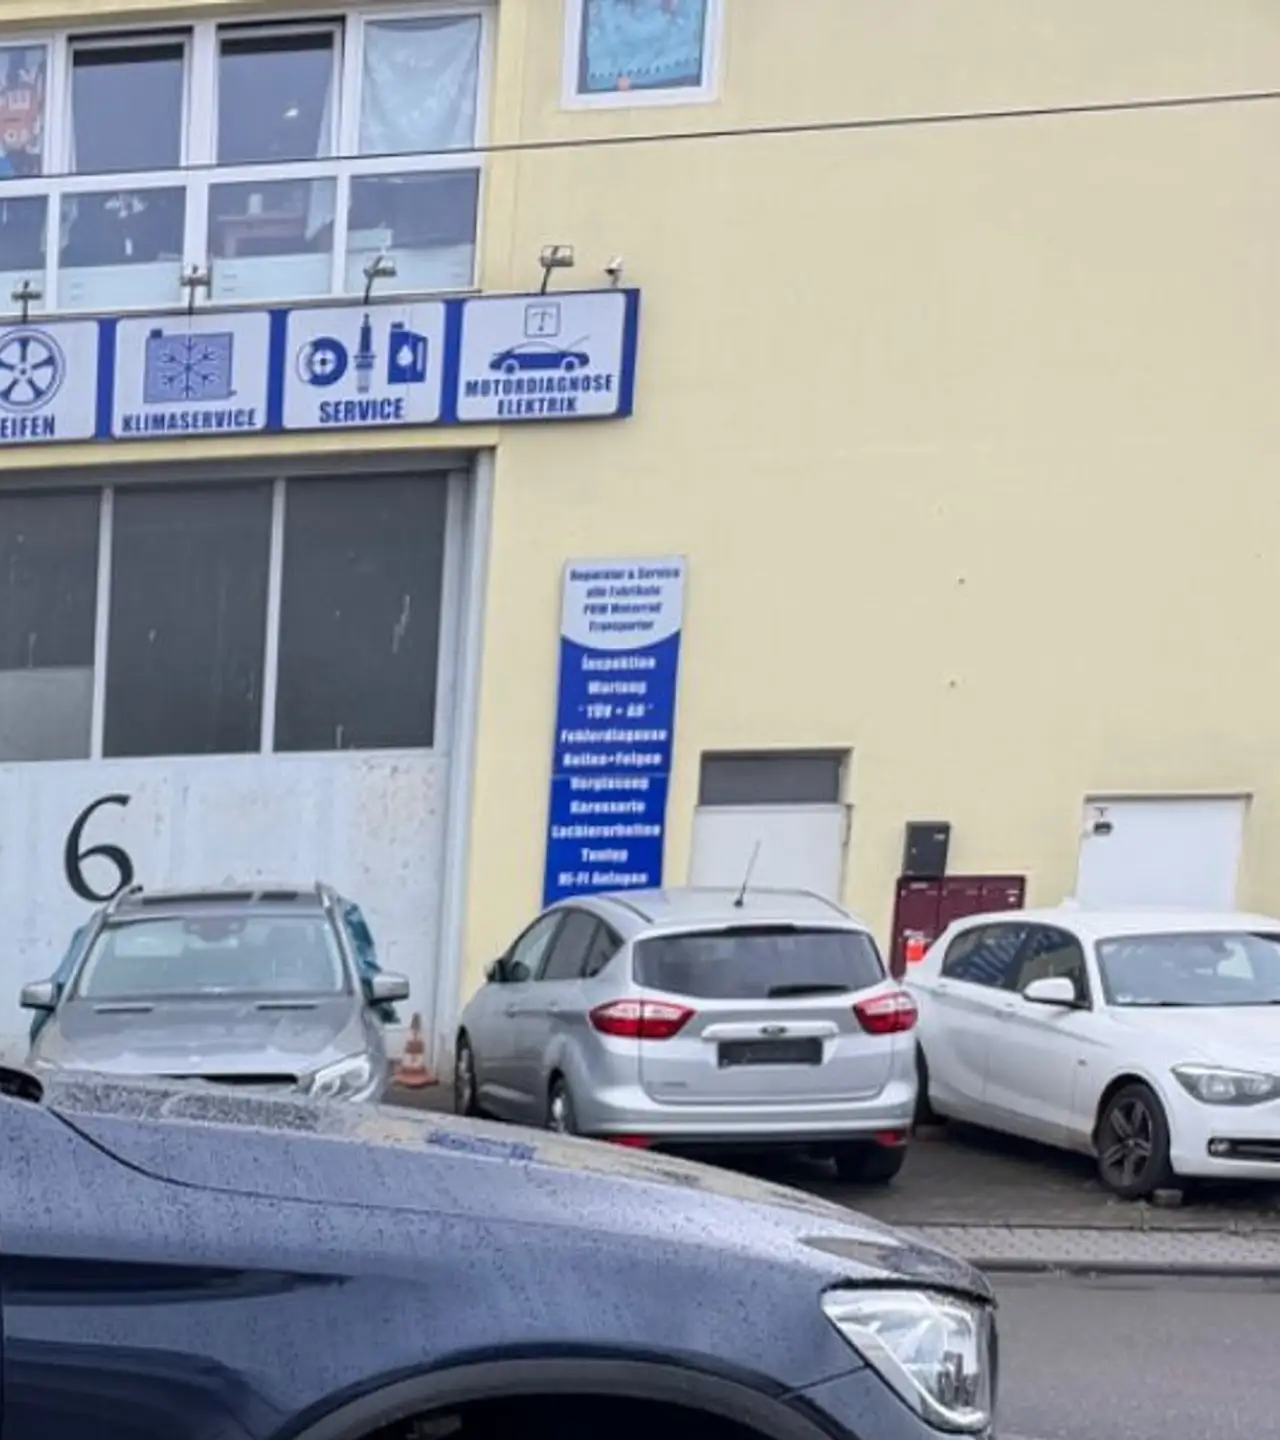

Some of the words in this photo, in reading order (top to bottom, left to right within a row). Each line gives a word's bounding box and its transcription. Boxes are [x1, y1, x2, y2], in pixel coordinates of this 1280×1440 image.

[465, 374, 614, 397] MOTORDIAGNOSE
[319, 398, 404, 424] SERVICE
[497, 397, 577, 416] ELEKTRIK
[122, 408, 256, 432] KLIMASERVICE
[638, 567, 680, 580] Service
[581, 654, 656, 671] Inspektion
[64, 794, 135, 901] 6
